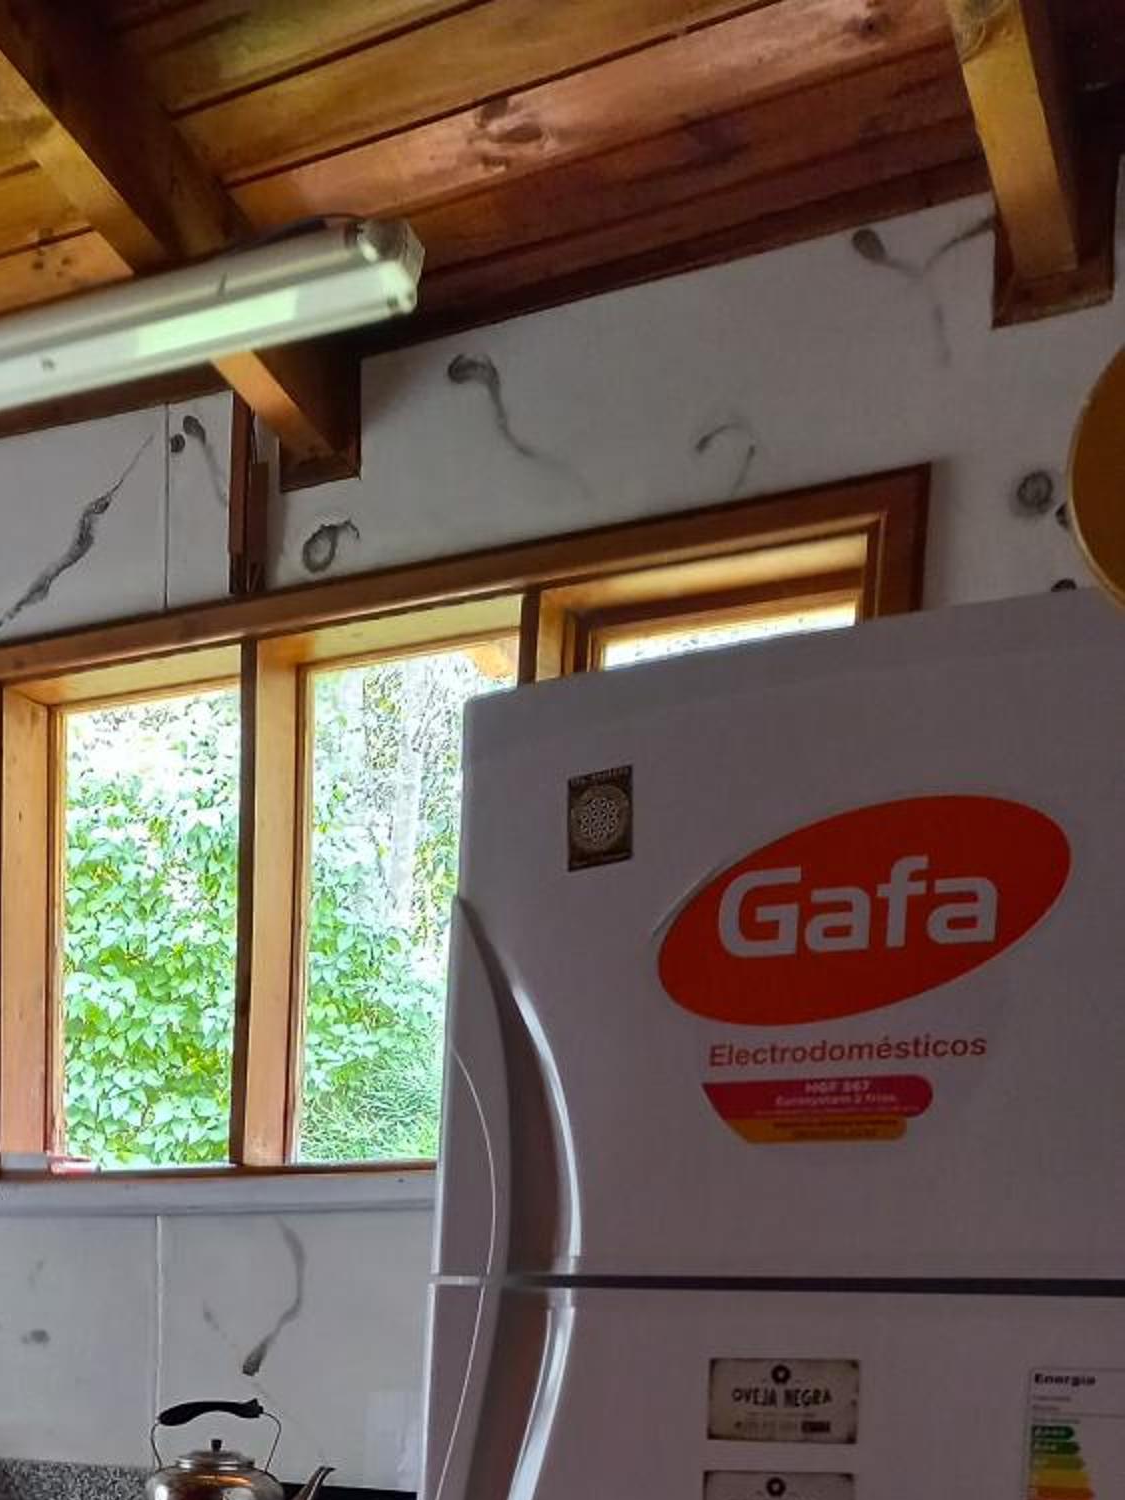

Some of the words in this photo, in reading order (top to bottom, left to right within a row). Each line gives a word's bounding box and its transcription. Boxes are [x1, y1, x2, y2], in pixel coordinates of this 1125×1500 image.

[718, 854, 999, 960] Gafa
[708, 1032, 988, 1069] Electrodomésticos
[731, 1386, 778, 1408] OVEJA
[783, 1387, 832, 1408] NEGRA
